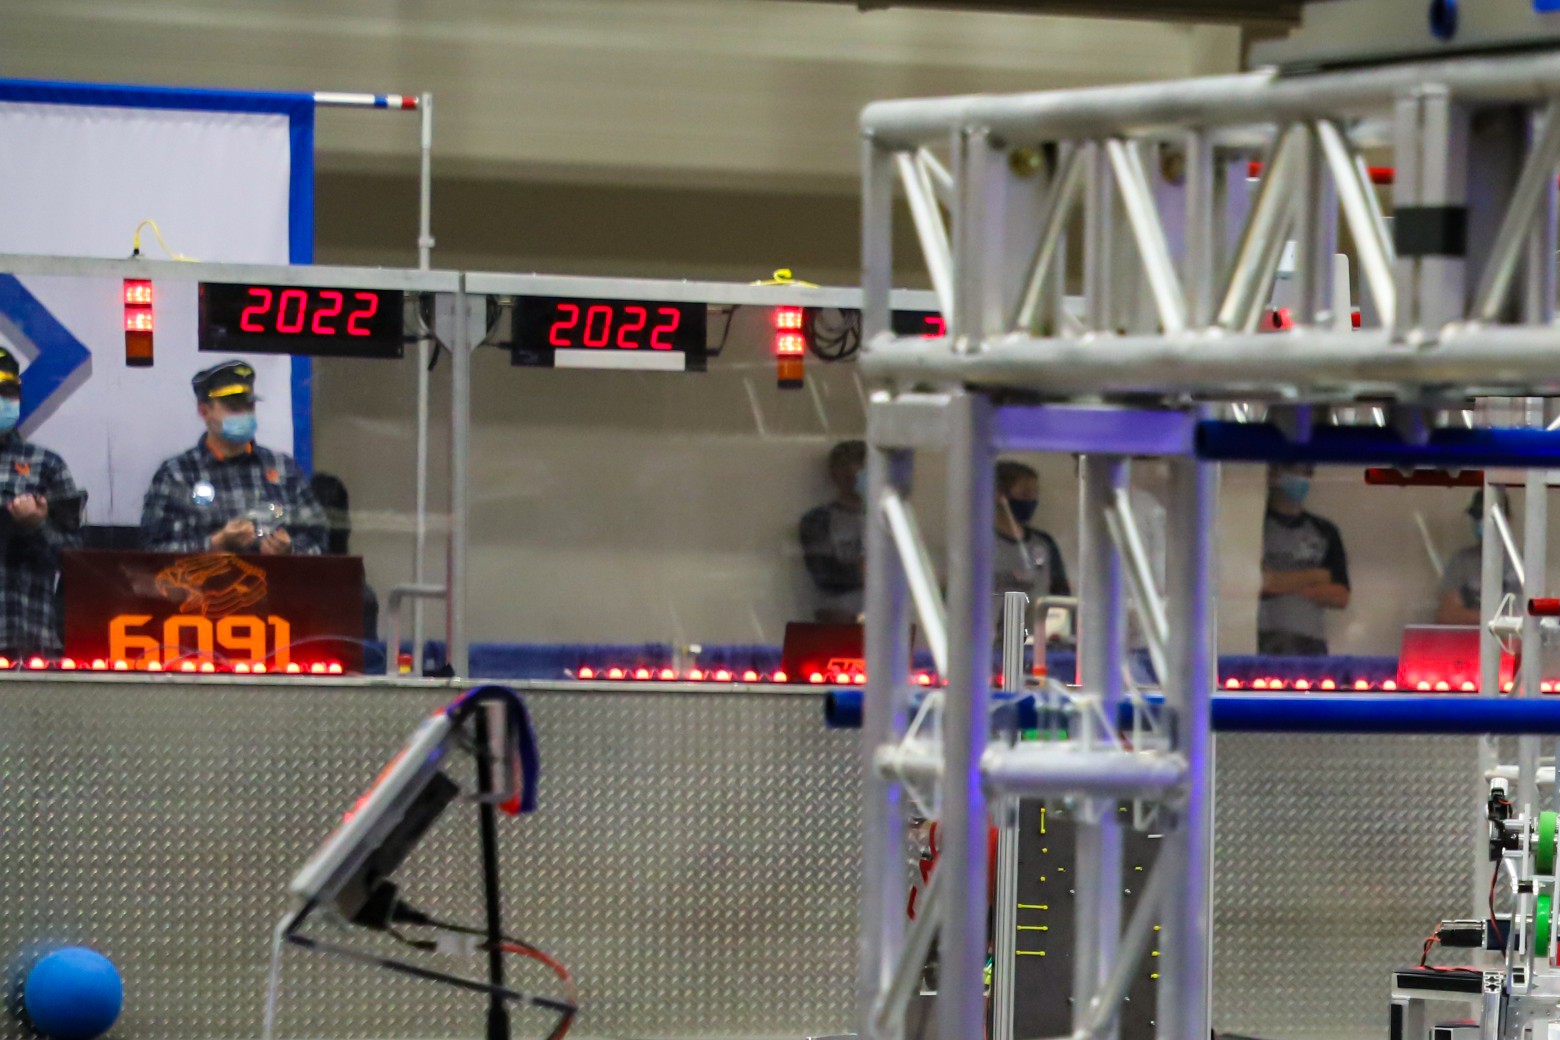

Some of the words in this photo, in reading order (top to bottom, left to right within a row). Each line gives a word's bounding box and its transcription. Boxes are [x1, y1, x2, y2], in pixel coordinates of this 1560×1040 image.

[240, 287, 379, 337] 2022
[549, 303, 681, 350] 2022
[110, 614, 290, 672] 6091
